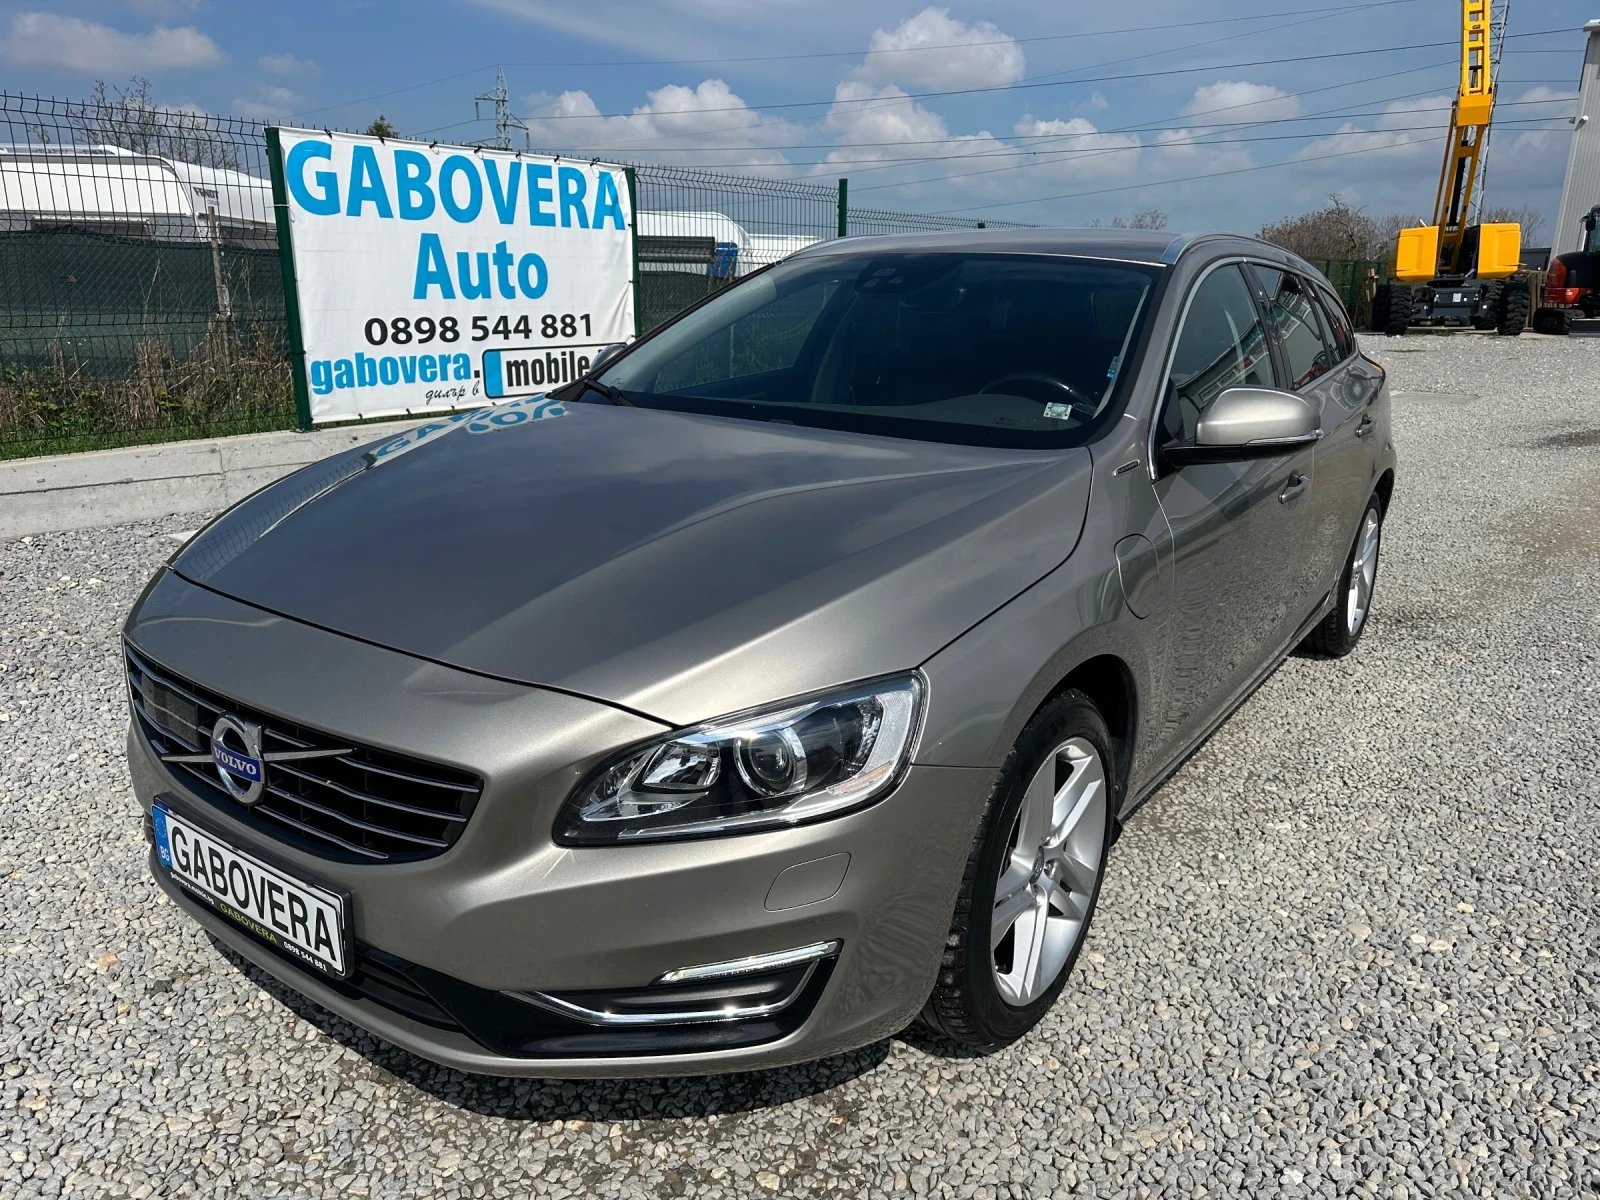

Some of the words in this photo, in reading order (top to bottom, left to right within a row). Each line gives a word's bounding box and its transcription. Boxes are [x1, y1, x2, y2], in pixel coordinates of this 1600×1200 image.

[286, 139, 626, 231] GABOVERA
[413, 233, 548, 301] Auto
[364, 316, 460, 346] 0898
[471, 314, 532, 342] 544
[541, 313, 592, 339] 881
[425, 386, 466, 405] дилър
[213, 746, 257, 775] VOLVO
[160, 845, 170, 862] BG
[171, 825, 337, 962] GABOVERA
[220, 903, 278, 944] GABOVERA
[283, 941, 300, 956] 0898
[300, 951, 313, 964] 544
[314, 958, 328, 972] 881
